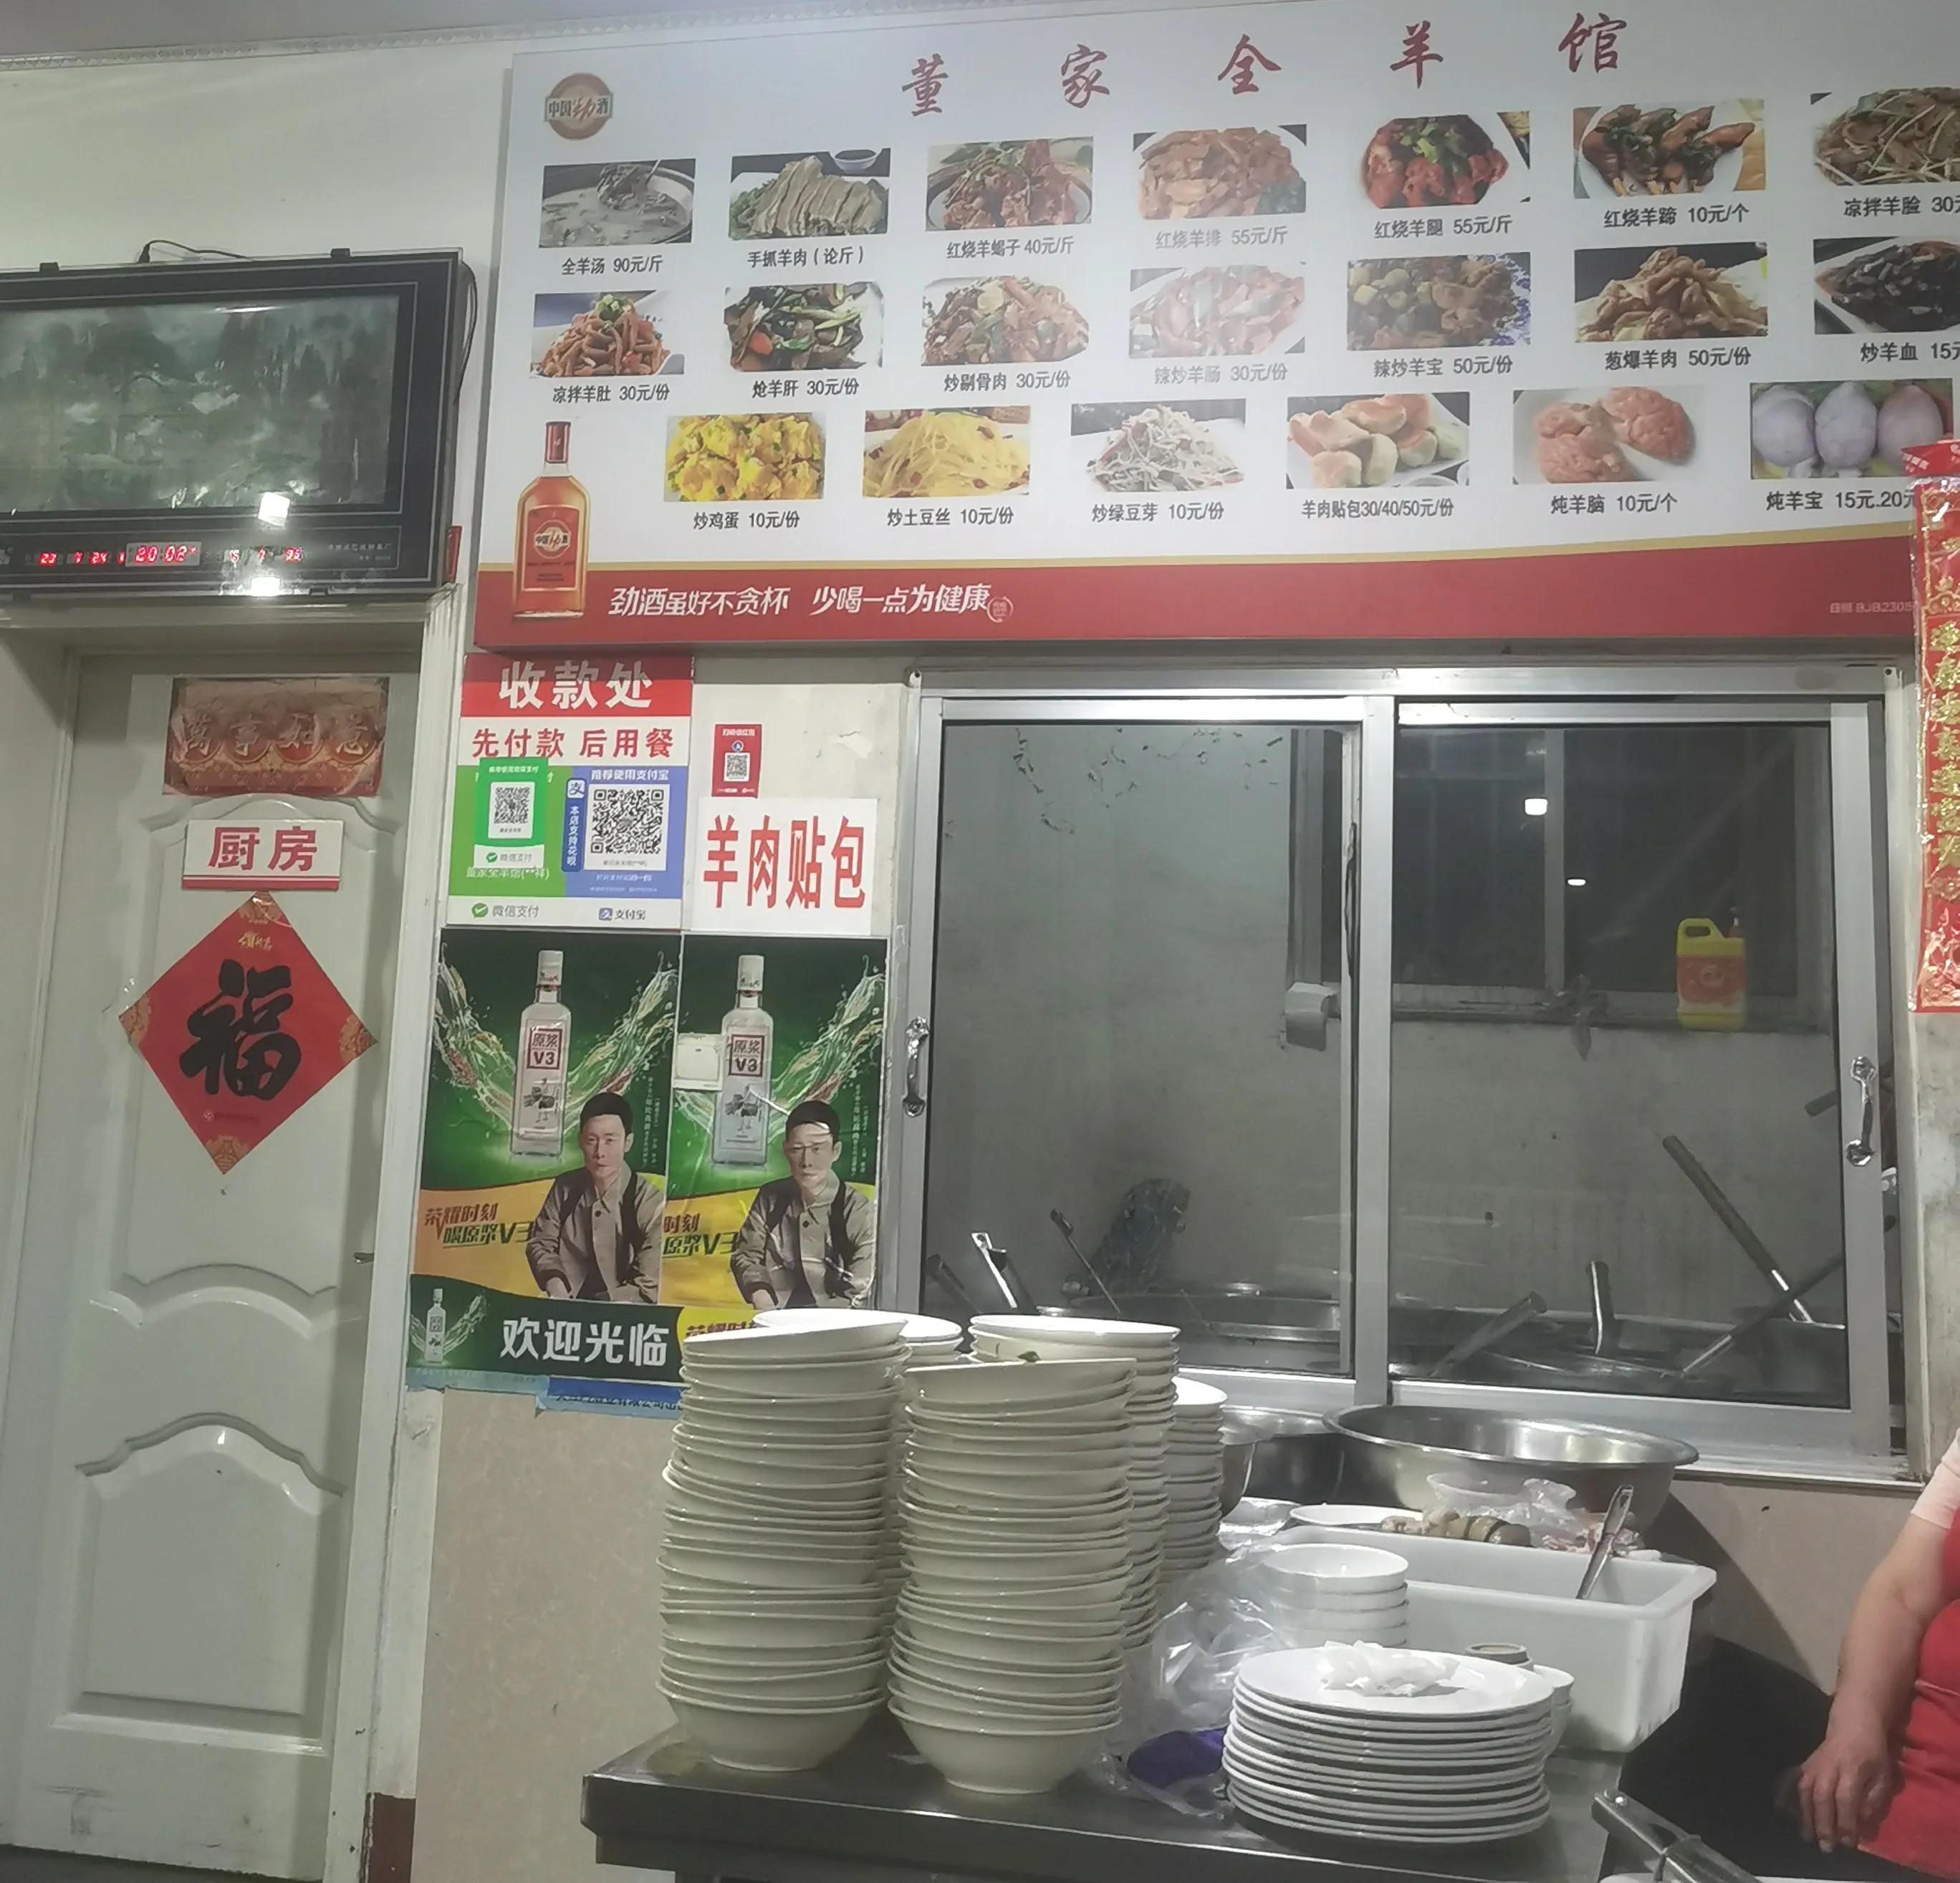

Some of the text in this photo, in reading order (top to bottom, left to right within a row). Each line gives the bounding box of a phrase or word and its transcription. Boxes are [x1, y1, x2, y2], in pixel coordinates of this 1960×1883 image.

[901, 11, 1626, 117] 董家全羊馆
[1453, 216, 1513, 236] 55元/斤
[1687, 204, 1750, 226] 10元/个
[946, 236, 1075, 260] 红烧羊蝎子 40元/斤
[1155, 226, 1288, 251] 红烧羊排 55元/斤
[561, 254, 663, 276] 全羊汤 90元/斤
[1605, 347, 1752, 370] 葱爆羊肉 50元/份
[1860, 344, 1918, 362] 炒羊血
[1153, 362, 1288, 385] 辣炒羊肠 30元/份
[1373, 355, 1514, 378] 辣炒羊宝 50元/份
[751, 377, 860, 399] 炝羊肝 30元/份
[1016, 370, 1072, 390] 30元/份
[552, 382, 671, 403] 凉拌羊肚 30元/份
[1092, 501, 1225, 523] 炒绿豆芽 10元/份
[1301, 498, 1454, 520] 羊肉贴包30/40/50元/份
[1551, 493, 1678, 515] 炖羊脑 10元/个
[1766, 491, 1824, 511] 炖羊宝
[693, 510, 801, 530] 炒鸡蛋 10元/份
[887, 506, 1014, 526] 炒土豆丝 10元/份
[608, 586, 790, 619] 劲酒虽好不贪杯
[812, 582, 991, 615] 少喝一点为健康
[499, 660, 653, 709] 收款处
[472, 728, 674, 759] 先付款 后用餐
[208, 826, 317, 872] 厨房
[703, 815, 865, 910] 羊肉贴包
[492, 904, 539, 918] 微信支付
[179, 958, 302, 1101] 福
[533, 1051, 555, 1066] V3
[734, 1057, 758, 1073] V3
[501, 1317, 669, 1367] 欢迎光临
